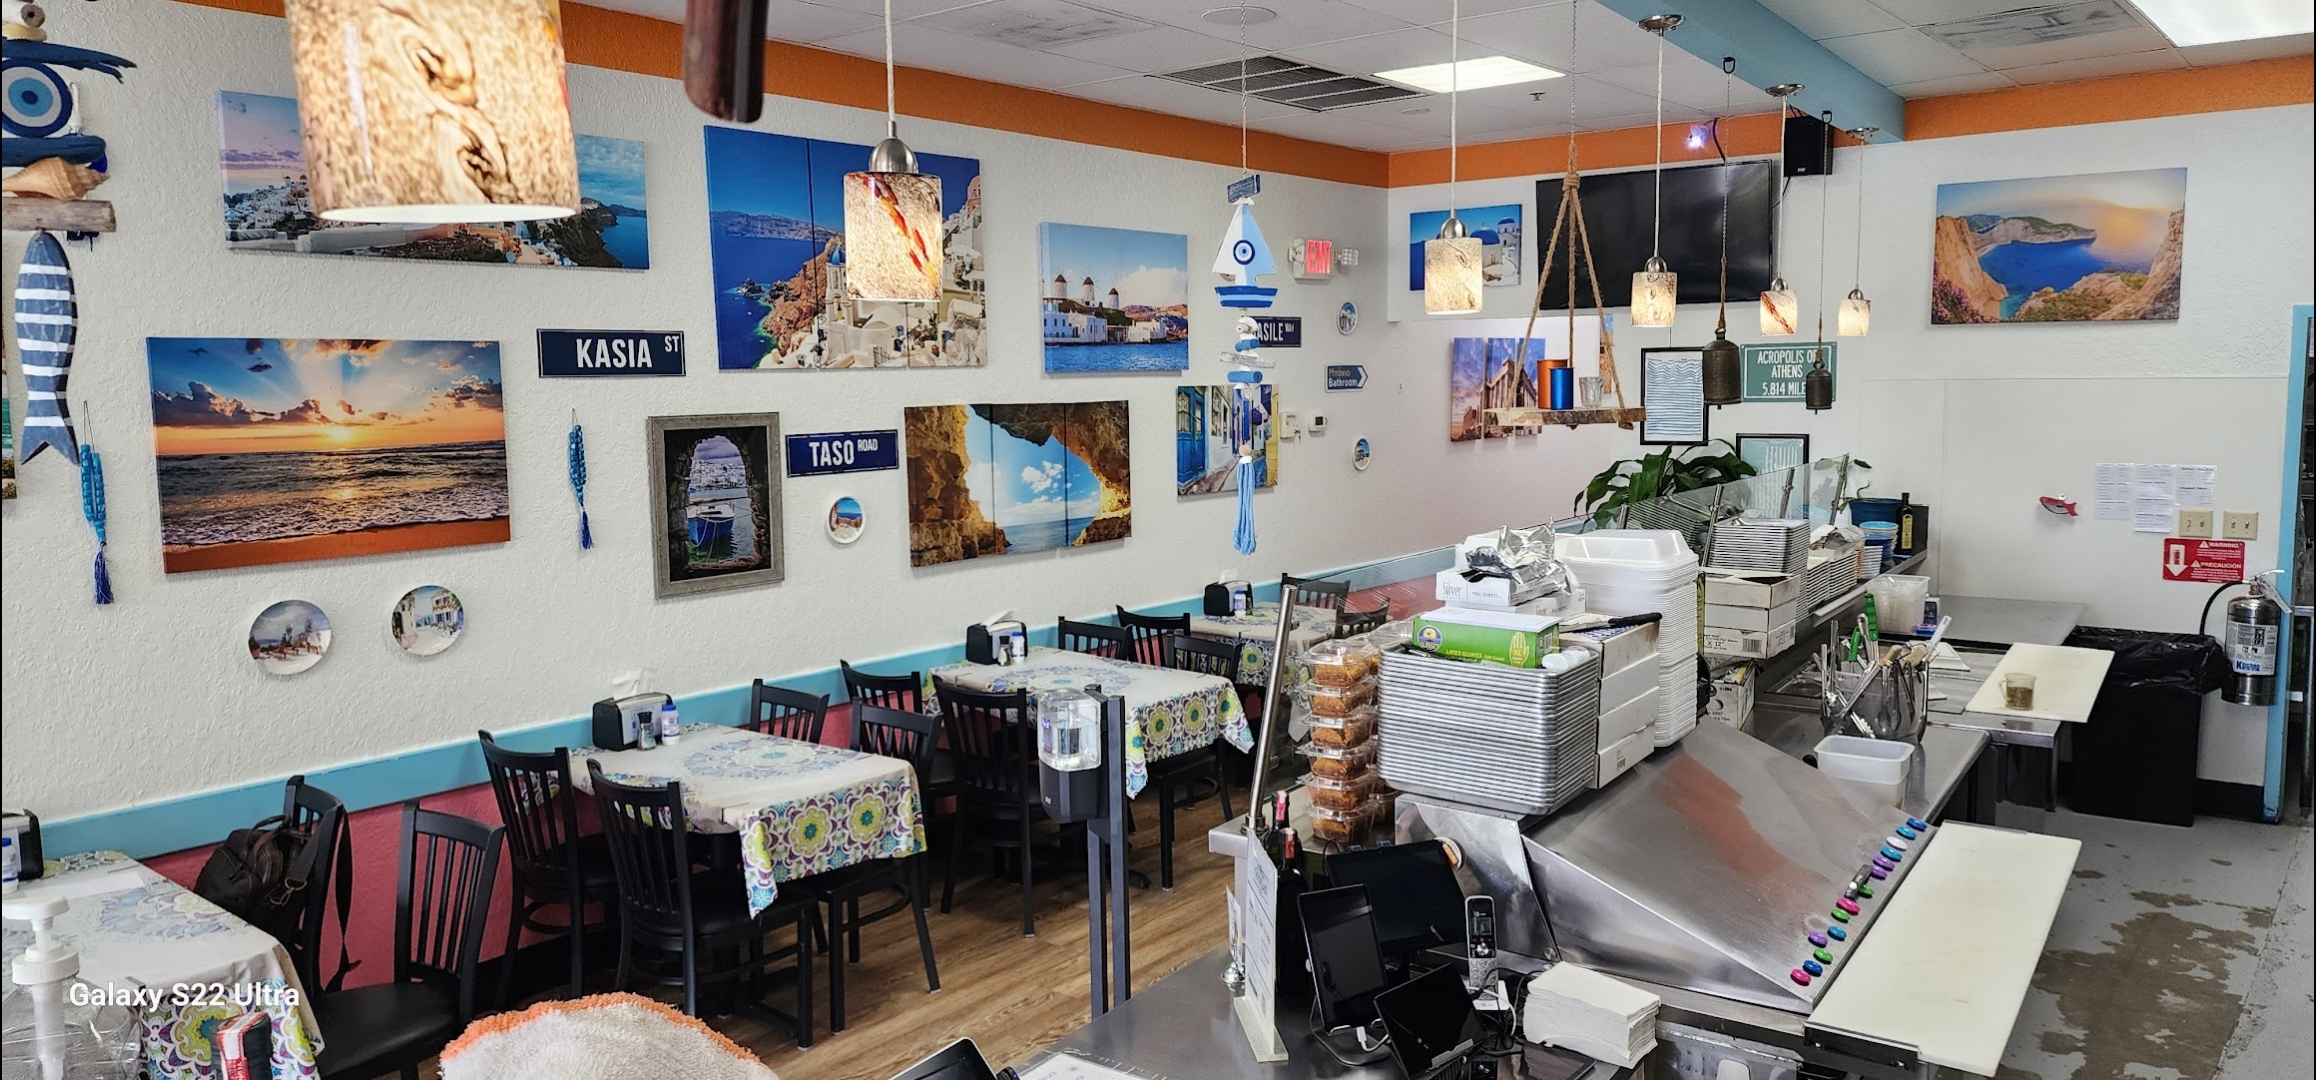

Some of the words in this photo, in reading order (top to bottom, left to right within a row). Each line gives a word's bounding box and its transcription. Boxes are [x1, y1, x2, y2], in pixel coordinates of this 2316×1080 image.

[1255, 322, 1284, 342] ASILE
[576, 338, 653, 369] KASIA
[664, 335, 680, 353] ST
[1757, 350, 1804, 364] ACROPOLIS
[1771, 365, 1803, 378] ATHENS
[1329, 378, 1358, 387] Bathroom
[1788, 381, 1806, 396] MILE
[809, 439, 855, 468] TASO
[857, 438, 878, 452] ROAD
[2209, 541, 2239, 549] WARNING
[2200, 561, 2242, 569] PRECAUCIÓN
[1442, 579, 1463, 597] Silver
[1461, 650, 1483, 659] GLOVES
